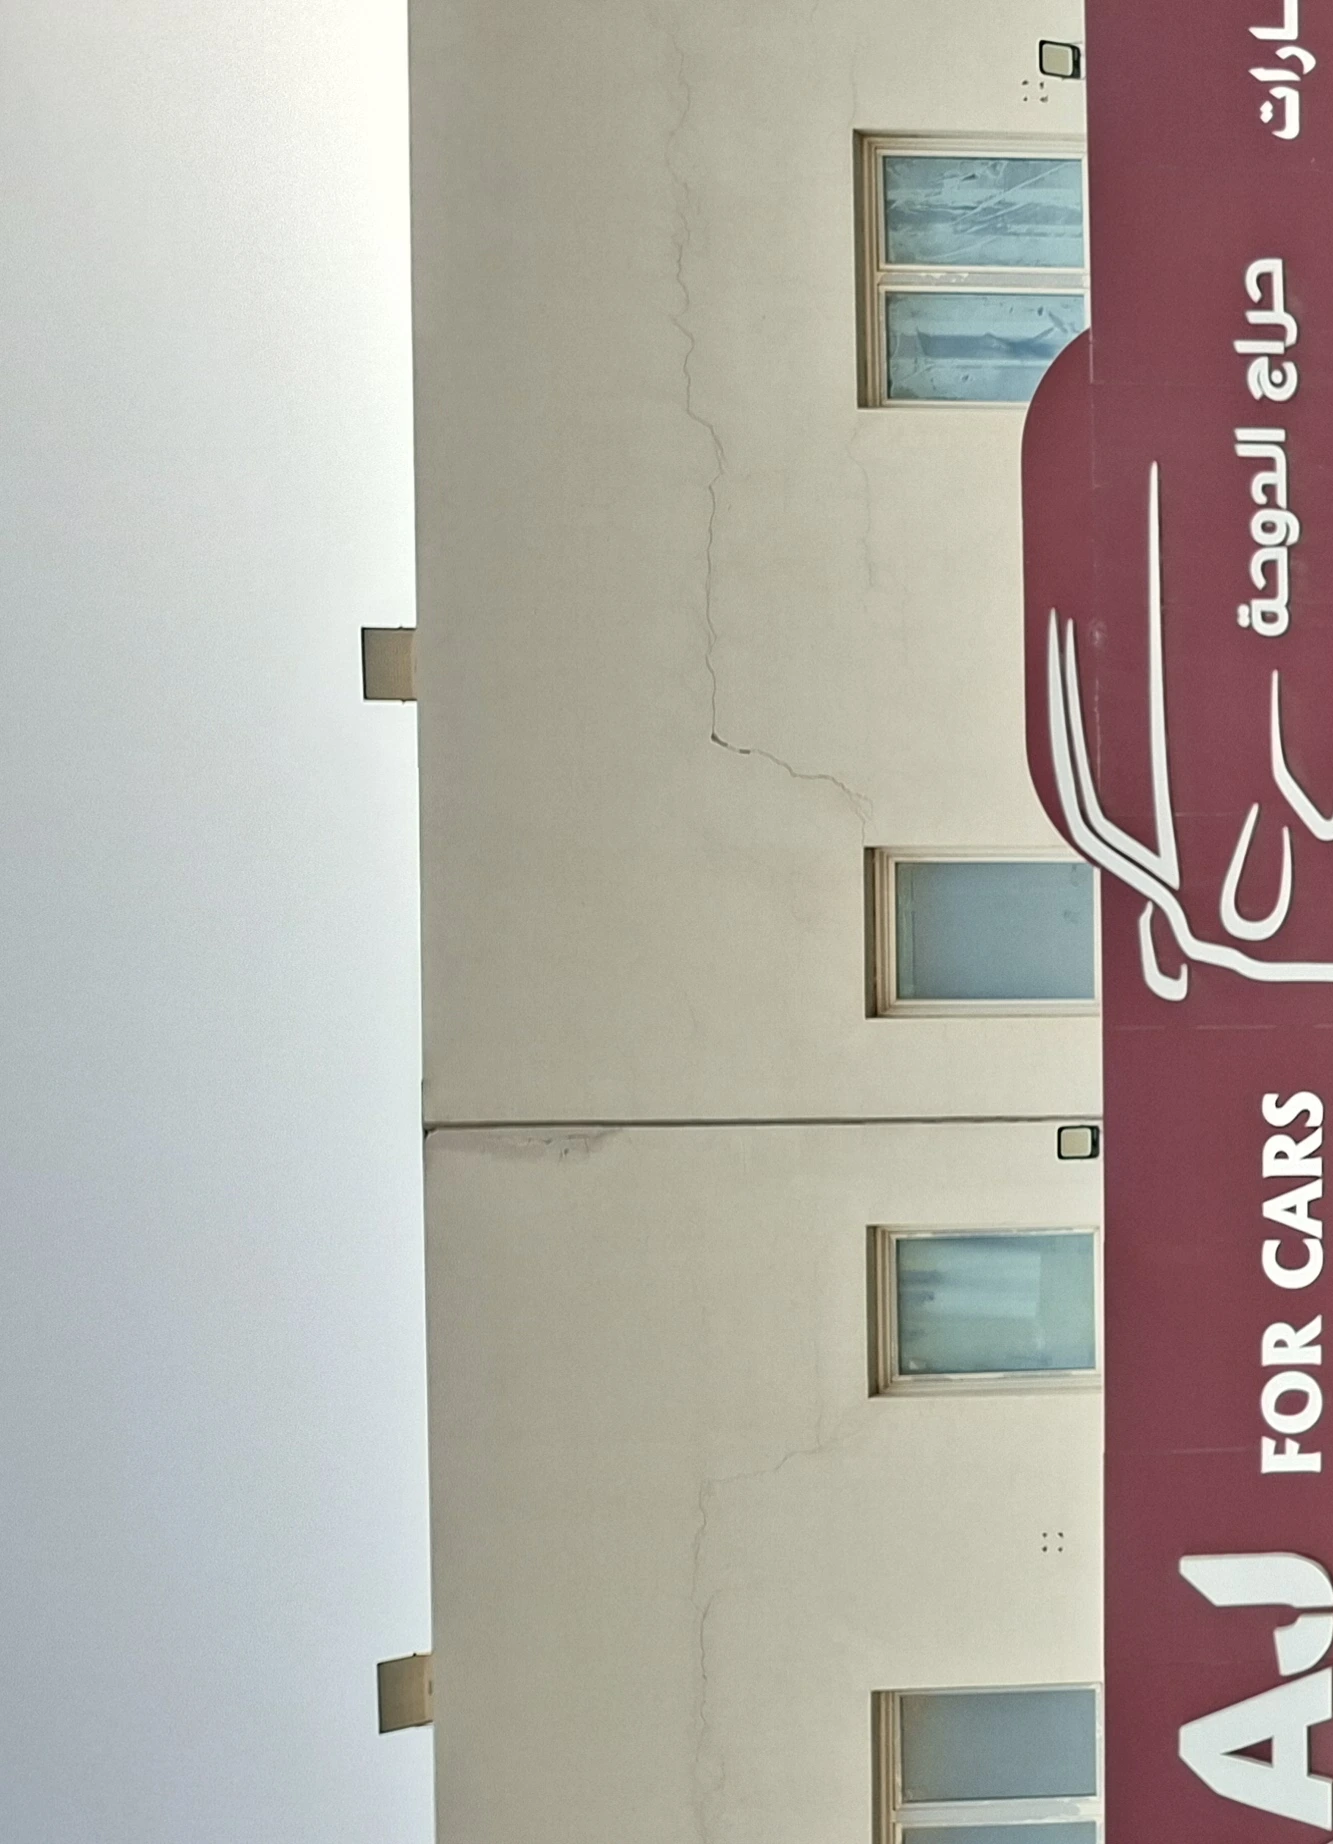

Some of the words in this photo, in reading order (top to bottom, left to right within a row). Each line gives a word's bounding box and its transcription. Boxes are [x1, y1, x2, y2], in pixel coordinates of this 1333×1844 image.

[1248, 0, 1316, 140] ارات
[1234, 258, 1298, 402] حراج
[1235, 427, 1299, 637] الدوحة
[1261, 1091, 1324, 1290] CARS
[1260, 1314, 1323, 1474] FOR
